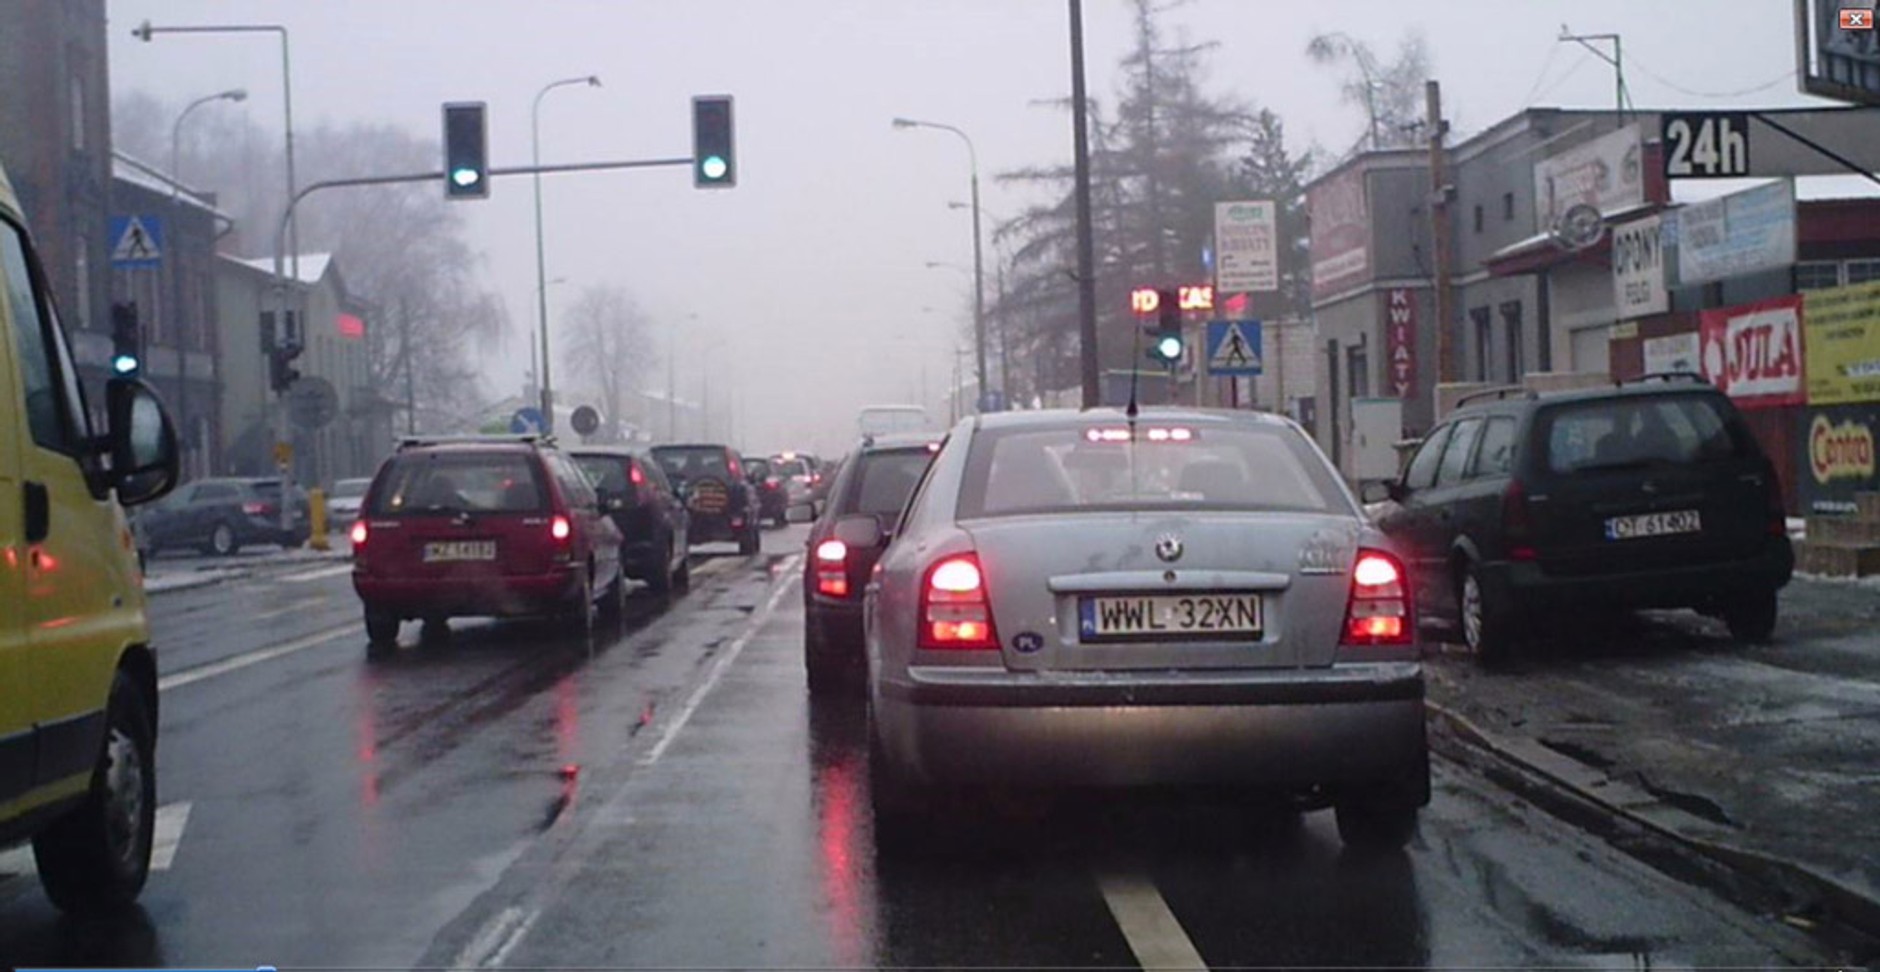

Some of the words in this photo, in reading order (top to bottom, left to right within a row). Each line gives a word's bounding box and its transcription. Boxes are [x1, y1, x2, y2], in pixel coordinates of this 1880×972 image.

[1667, 118, 1747, 176] 24h
[1615, 224, 1662, 275] OPONY
[1391, 288, 1411, 397] KWIATY
[1729, 322, 1798, 382] JULA
[1100, 599, 1166, 630] WWL
[1178, 598, 1257, 630] 32XN
[1018, 636, 1037, 649] PL
